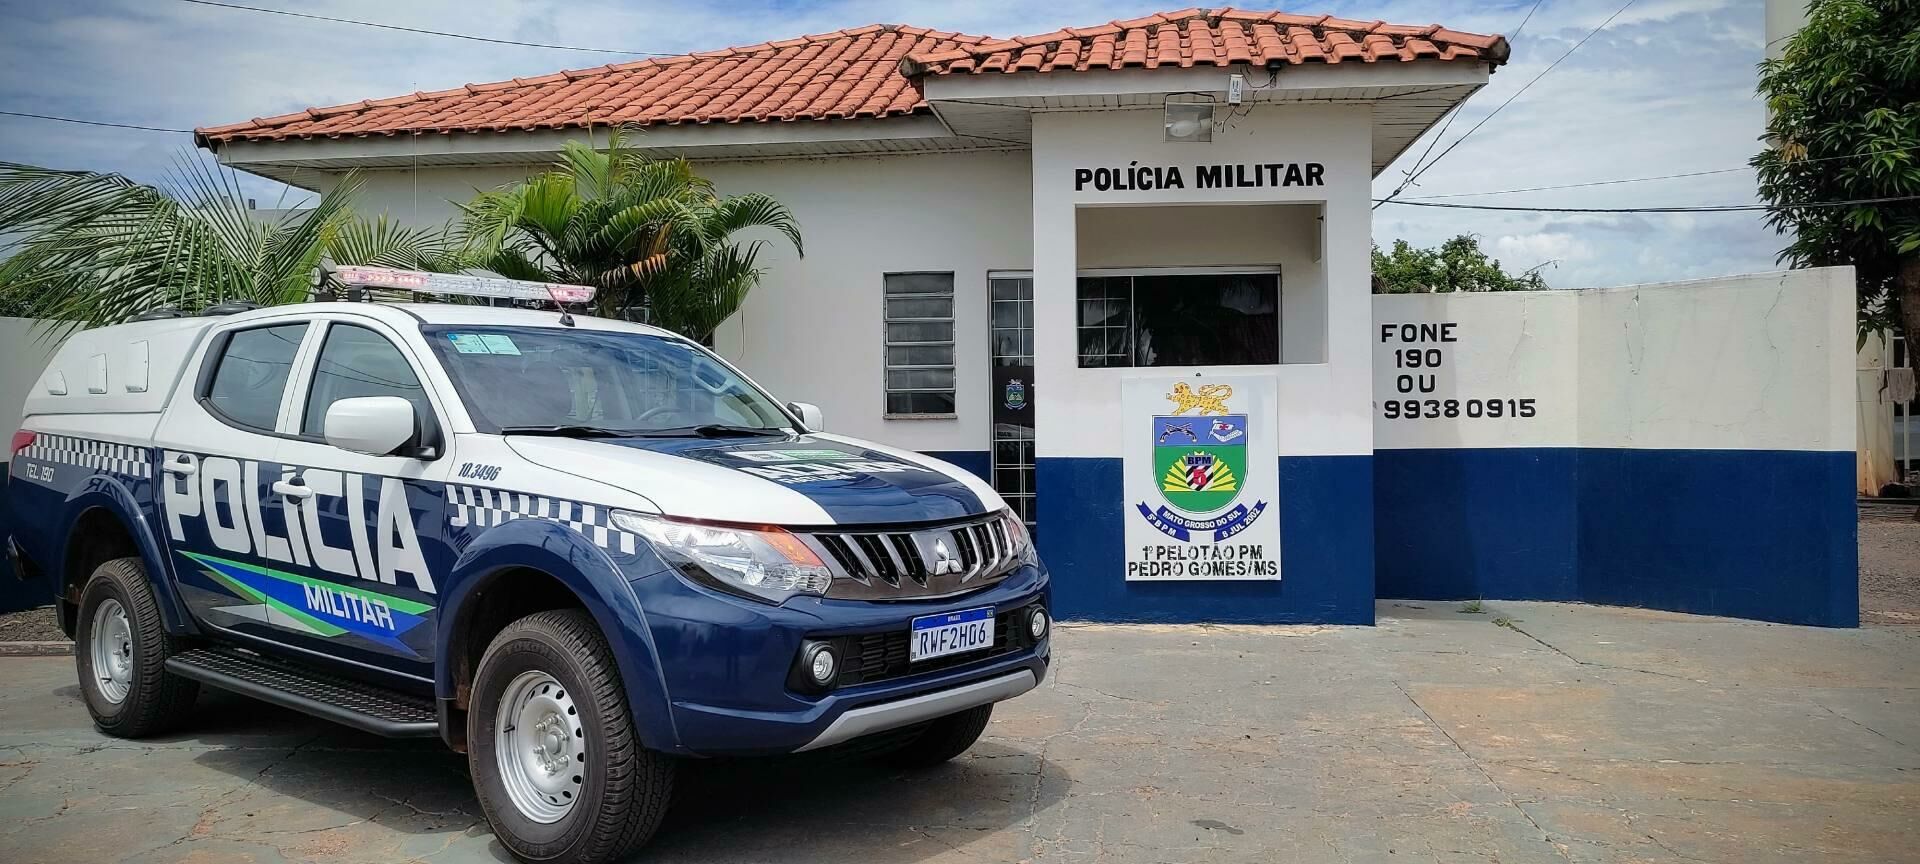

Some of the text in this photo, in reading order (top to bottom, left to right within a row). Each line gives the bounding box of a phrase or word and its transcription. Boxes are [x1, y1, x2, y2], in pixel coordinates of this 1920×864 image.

[1075, 161, 1325, 191] POLÍCIA MILITAR
[1381, 322, 1458, 343] FONE
[1395, 348, 1442, 368] 190
[1396, 374, 1436, 393] OU
[1187, 456, 1212, 465] BPM
[25, 463, 54, 483] TEL. 190
[457, 462, 502, 481] 10.3496
[1162, 510, 1242, 529] MATO GROSSO DO SUL
[1230, 523, 1245, 535] JUL
[1243, 508, 1261, 525] 2002
[1156, 542, 1234, 560] PELOTÃO
[1239, 544, 1263, 560] PM
[1128, 560, 1278, 577] PEDRO GOMES/MS
[303, 582, 395, 631] MILITAR
[920, 621, 986, 656] RWF2H06
